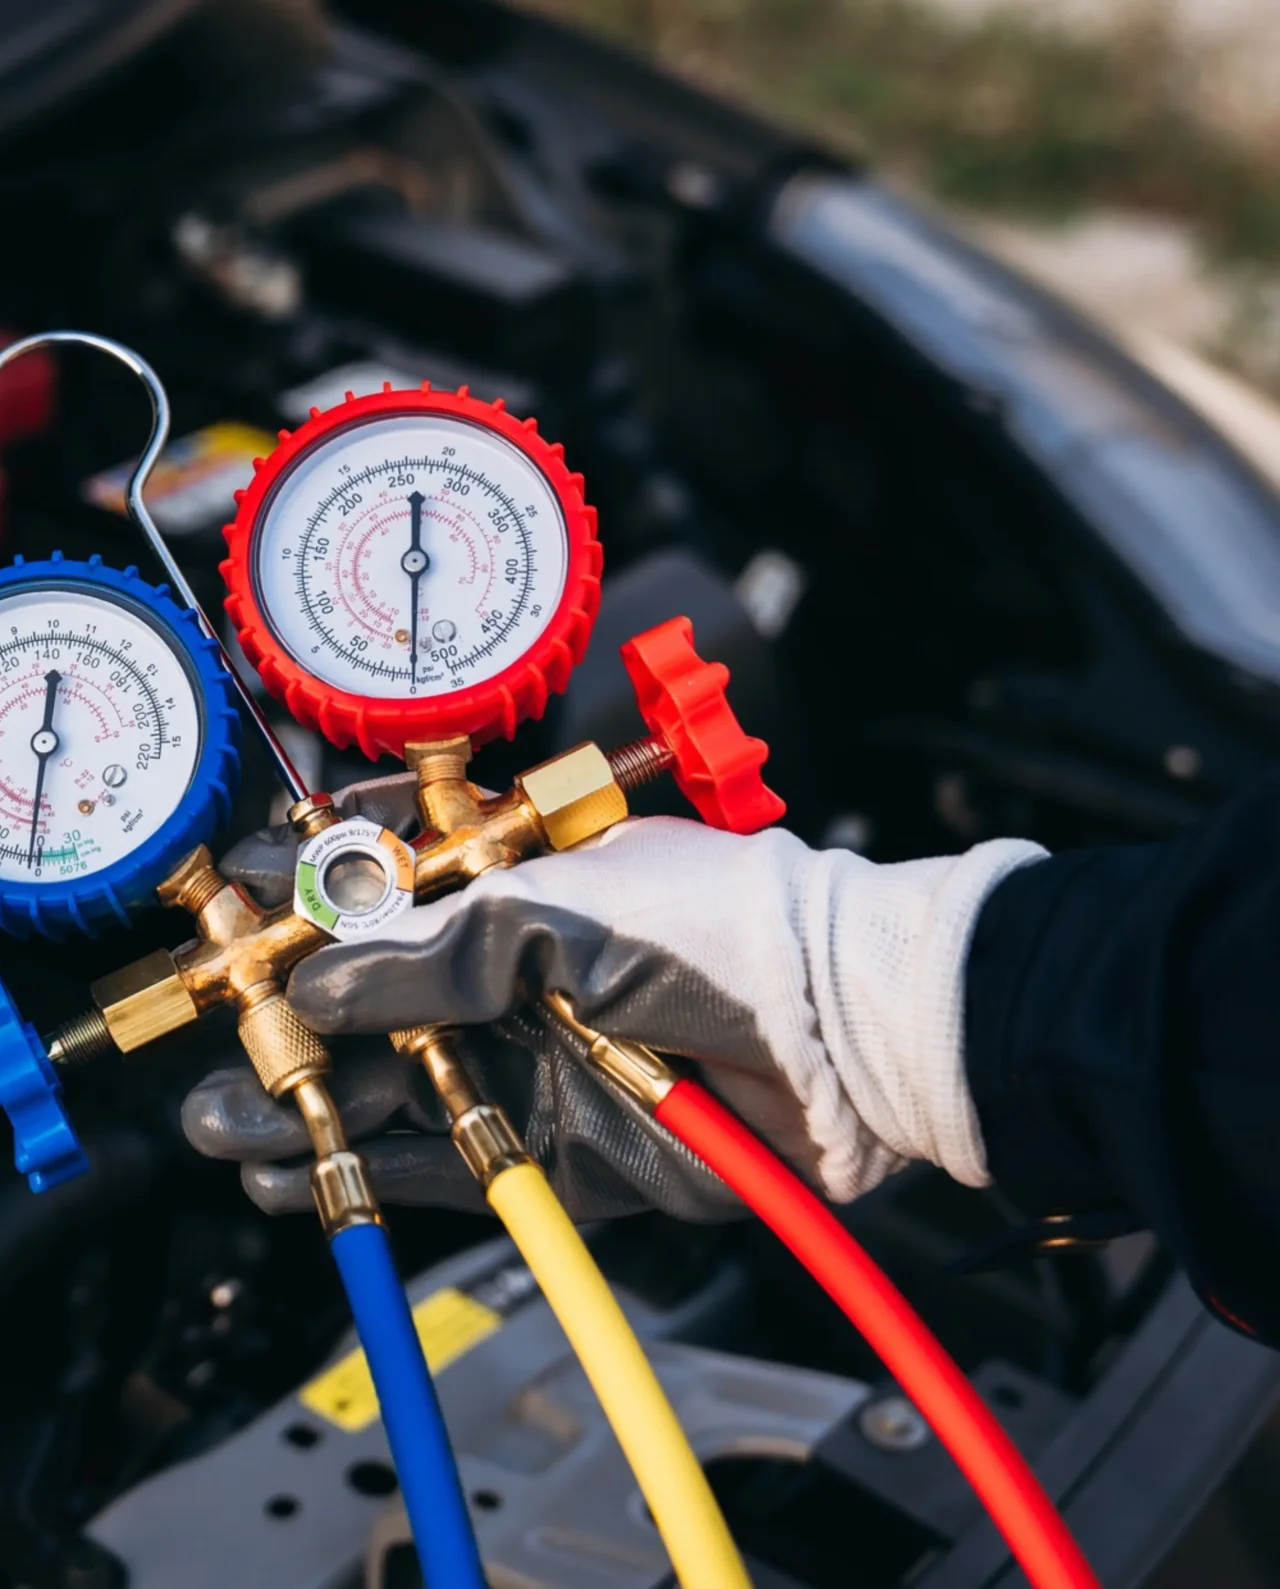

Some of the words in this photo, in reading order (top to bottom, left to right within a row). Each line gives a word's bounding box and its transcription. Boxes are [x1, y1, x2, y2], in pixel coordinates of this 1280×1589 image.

[442, 446, 455, 456] 20
[338, 464, 351, 476] 15
[388, 473, 415, 488] 250
[444, 478, 470, 496] 300
[337, 493, 363, 516] 200
[525, 505, 538, 518] 25
[488, 508, 509, 532] 350
[282, 548, 292, 560] 10
[313, 537, 330, 561] 150
[505, 559, 518, 584] 400
[316, 590, 333, 614] 100
[530, 604, 542, 618] 30
[47, 620, 59, 628] 10
[86, 624, 96, 633] 11
[481, 609, 502, 634] 450
[11, 626, 17, 635] 9
[120, 639, 132, 650] 12
[350, 636, 368, 651] 50
[35, 648, 60, 660] 140
[76, 652, 100, 668] 160
[431, 644, 458, 662] 500
[147, 663, 159, 676] 13
[422, 665, 434, 673] psi
[110, 671, 133, 693] 180
[450, 678, 464, 688] 35
[410, 686, 416, 694] 0
[166, 697, 176, 710] 14
[132, 703, 150, 729] 200
[172, 736, 181, 748] 15
[137, 743, 151, 770] 220
[120, 810, 131, 822] psi
[37, 836, 45, 846] 0
[63, 829, 81, 844] 30
[310, 844, 324, 862] MWP
[393, 846, 408, 868] WET
[35, 869, 41, 877] 0
[304, 888, 321, 911] DRY
